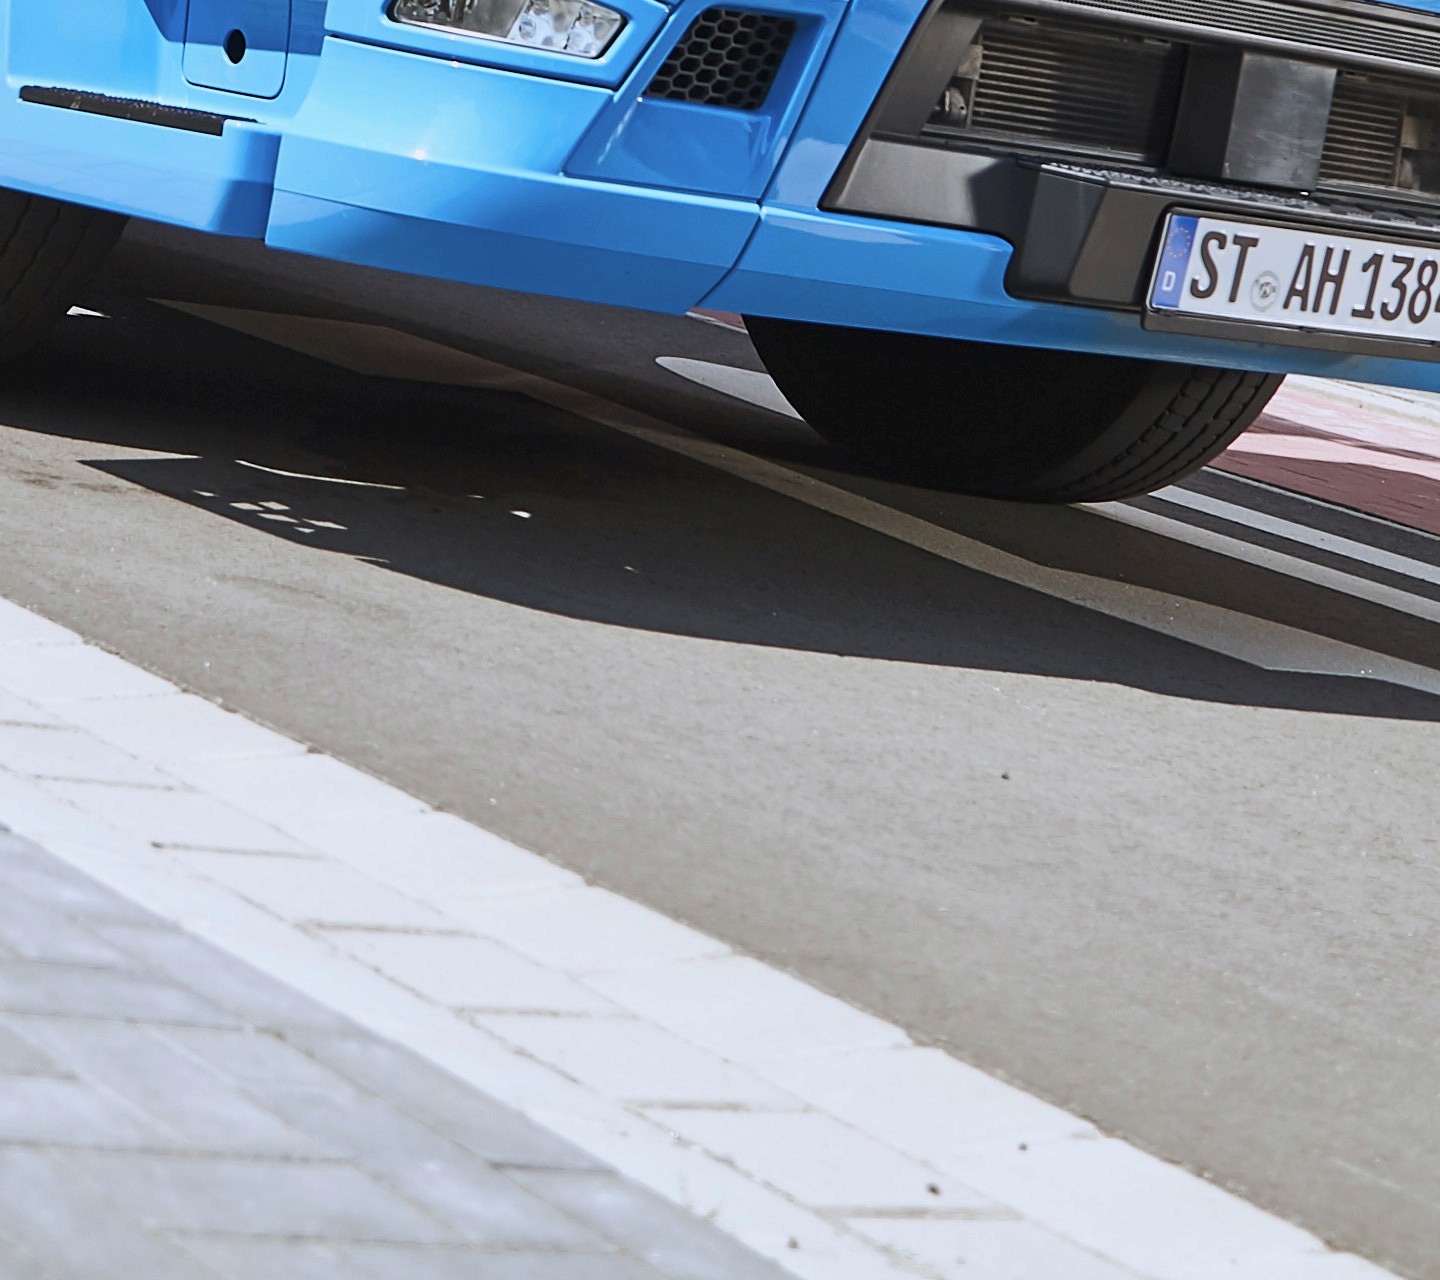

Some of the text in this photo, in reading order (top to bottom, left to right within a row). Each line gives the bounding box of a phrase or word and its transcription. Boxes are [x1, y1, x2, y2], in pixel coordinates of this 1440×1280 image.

[1160, 270, 1176, 293] D
[1189, 230, 1260, 304] ST
[1282, 241, 1351, 317] AH
